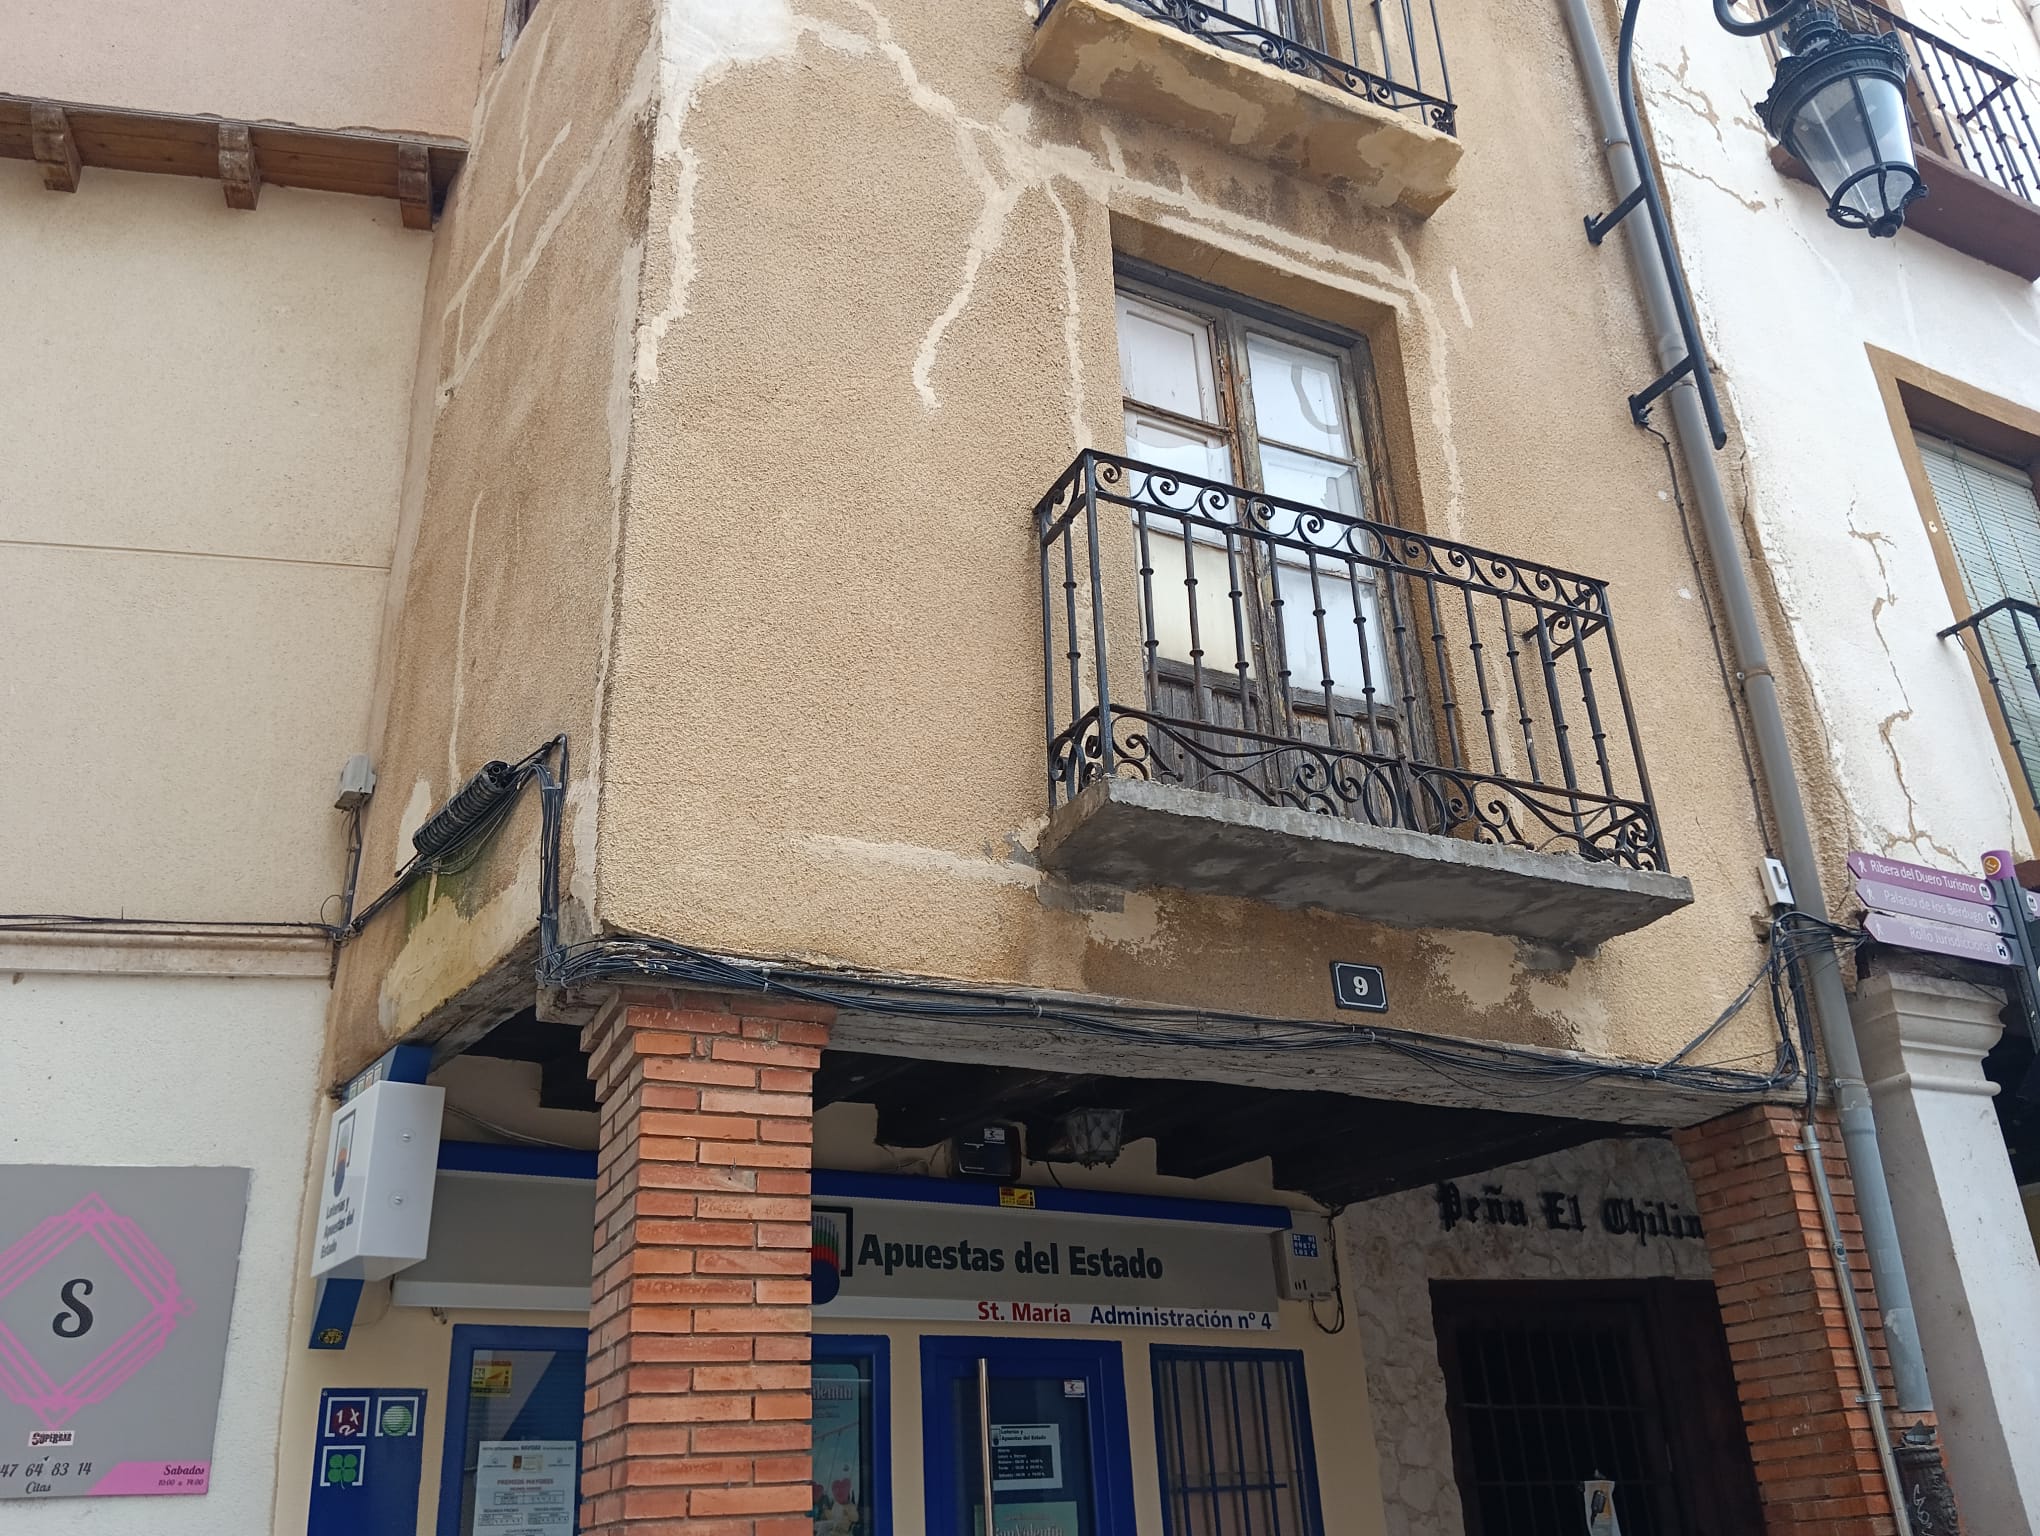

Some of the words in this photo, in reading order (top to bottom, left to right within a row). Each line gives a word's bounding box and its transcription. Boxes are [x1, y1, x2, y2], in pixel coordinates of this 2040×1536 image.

[1869, 859, 1900, 877] Ribera
[1901, 865, 1916, 881] del
[1916, 869, 1943, 887] Duero
[1943, 875, 1977, 894] Turismo
[1883, 889, 1917, 908] Palacio
[1919, 896, 1931, 911] de
[1931, 899, 1947, 915] los
[1946, 903, 1984, 924] Berdugo
[1908, 926, 1934, 943] Rollo
[1353, 976, 1369, 996] 9
[1437, 1181, 1529, 1232] Peña
[1541, 1191, 1587, 1232] El
[858, 1233, 1005, 1276] Apuestas
[1015, 1241, 1059, 1274] del
[1069, 1245, 1163, 1279] Estado
[52, 1278, 95, 1339] S
[978, 1301, 1005, 1321] St.
[1012, 1302, 1071, 1323] María
[1090, 1305, 1233, 1329] Administración
[1238, 1312, 1256, 1329] nº
[1261, 1313, 1272, 1329] 4
[0, 1463, 19, 1478] 47
[25, 1463, 44, 1477] 64
[51, 1462, 70, 1477] 83
[78, 1462, 93, 1476] 14
[163, 1464, 205, 1476] Sabados
[25, 1480, 52, 1494] Citas
